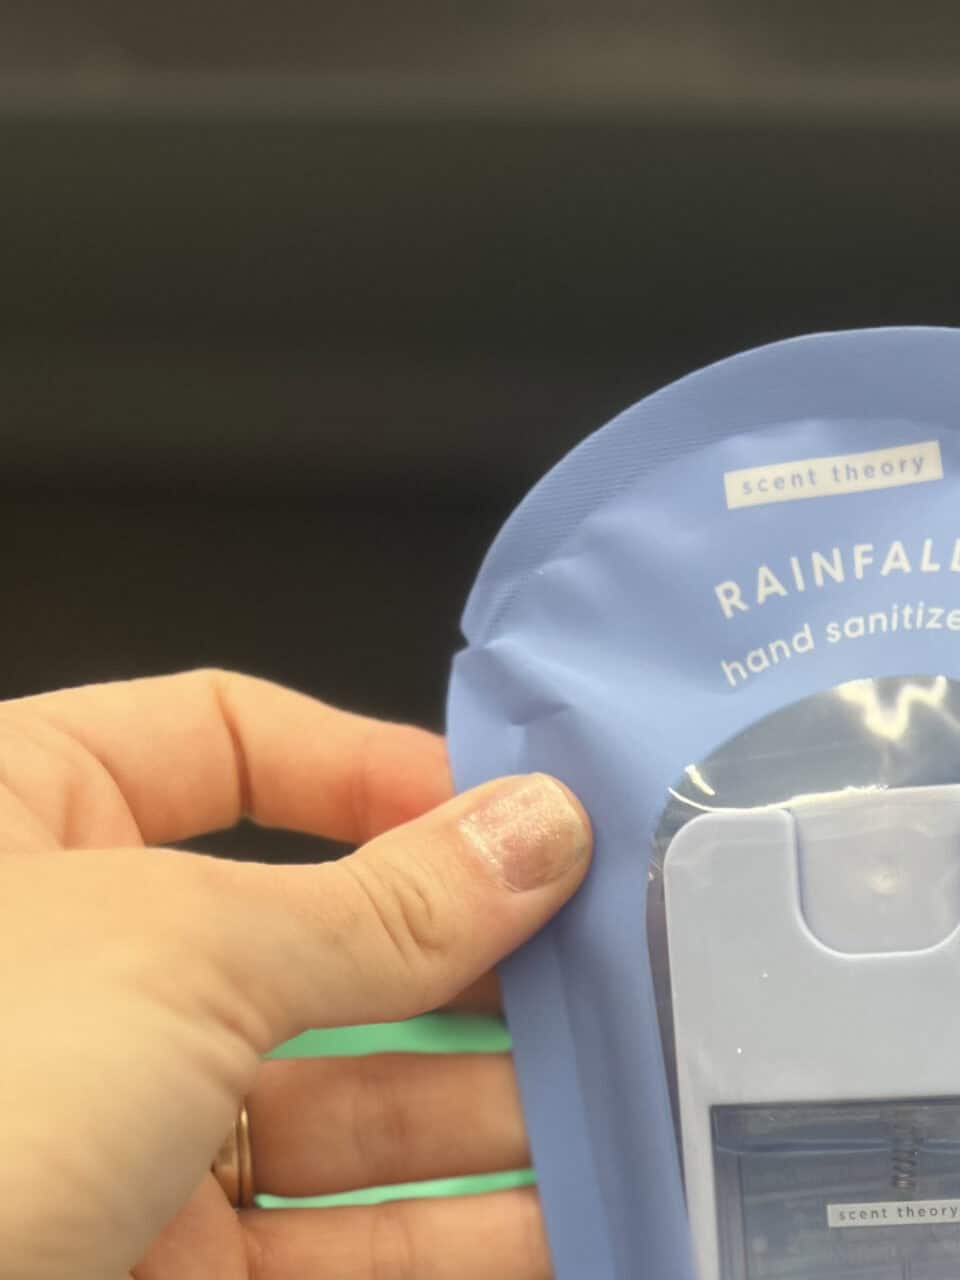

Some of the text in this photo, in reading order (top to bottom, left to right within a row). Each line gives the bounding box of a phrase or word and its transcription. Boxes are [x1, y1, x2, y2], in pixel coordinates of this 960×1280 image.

[742, 454, 926, 496] scent theory
[721, 624, 815, 686] hand
[839, 1204, 960, 1221] scent theory
